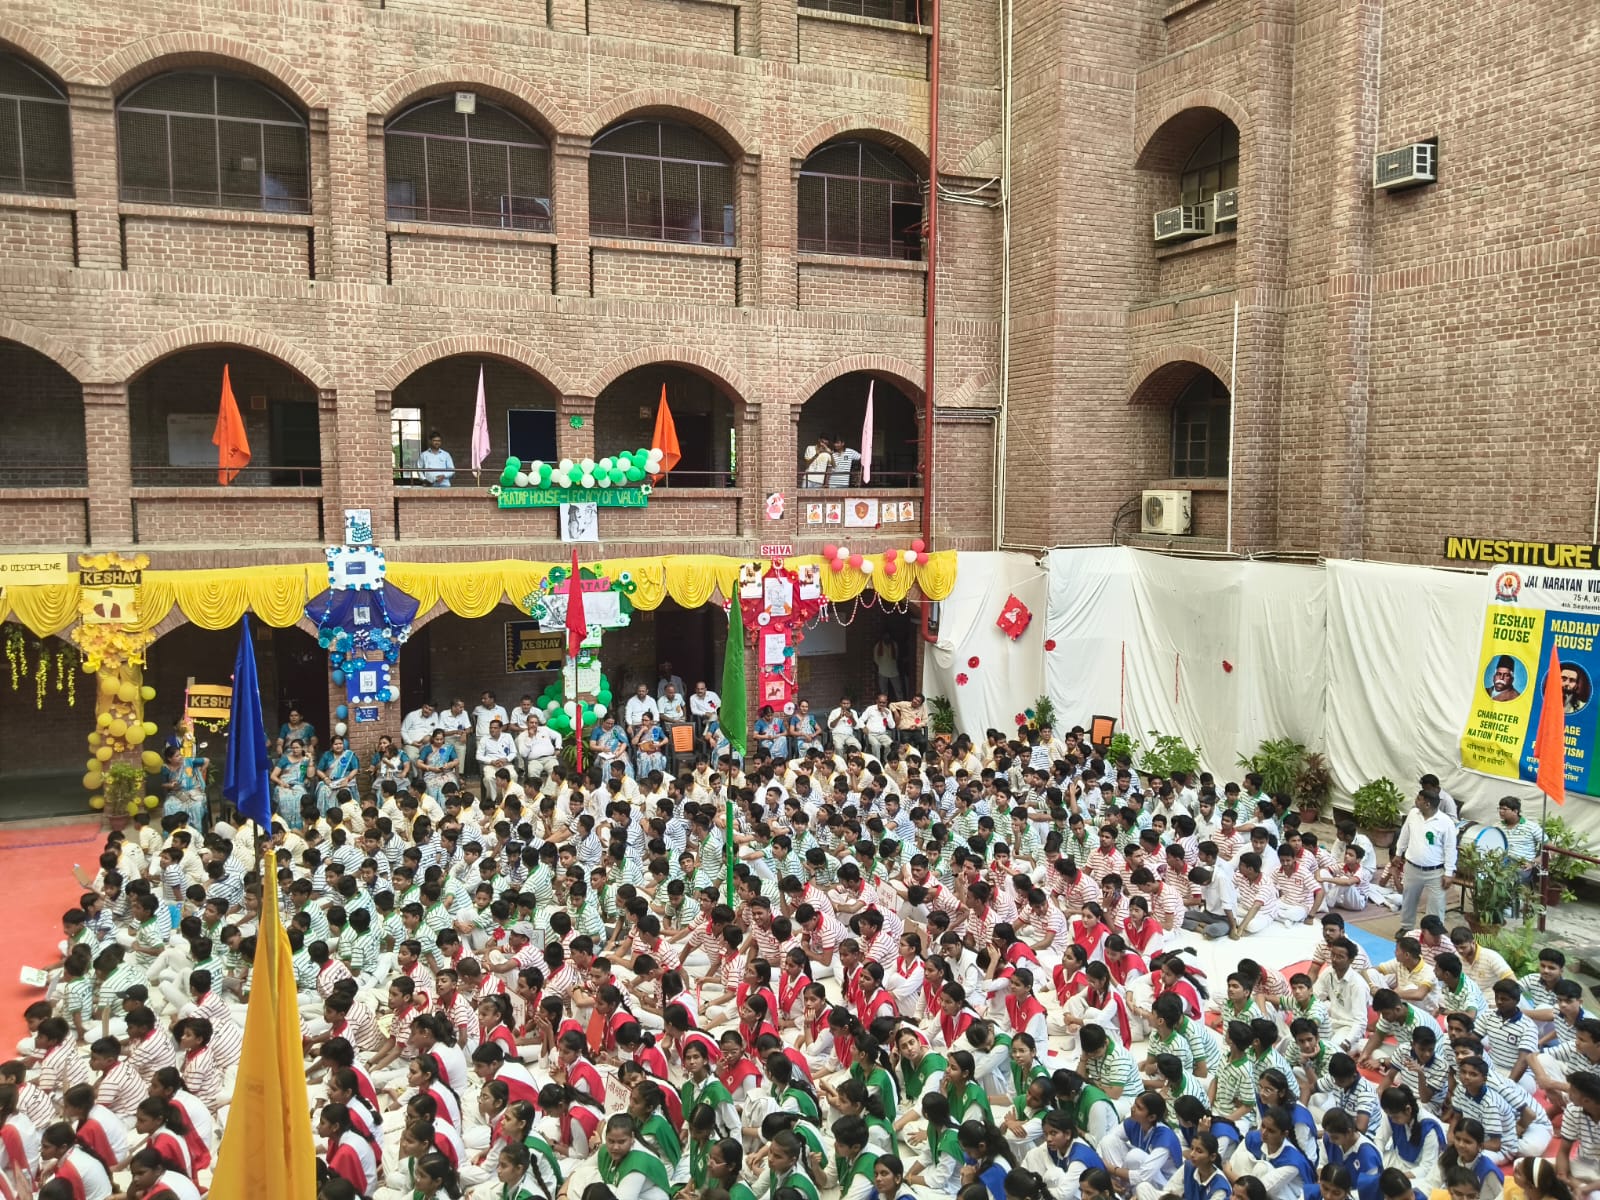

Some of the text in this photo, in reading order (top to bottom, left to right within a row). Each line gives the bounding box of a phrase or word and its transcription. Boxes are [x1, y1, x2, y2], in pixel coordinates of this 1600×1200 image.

[499, 490, 529, 505] PRATAP
[602, 489, 614, 505] OF
[762, 546, 791, 555] SHIVA
[1447, 537, 1593, 569] INVESTITURE
[11, 562, 61, 572] DISCIPLINE
[83, 572, 138, 584] KESHAV
[1524, 576, 1538, 588] JAI
[1542, 576, 1583, 593] NARAYAN
[1493, 613, 1536, 629] KESHAV
[1551, 619, 1600, 637] MADHAV
[1493, 627, 1530, 644] HOUSE
[1555, 634, 1593, 651] HOUSE
[522, 639, 562, 650] KESHAV
[1467, 728, 1519, 745] NATION FIRST
